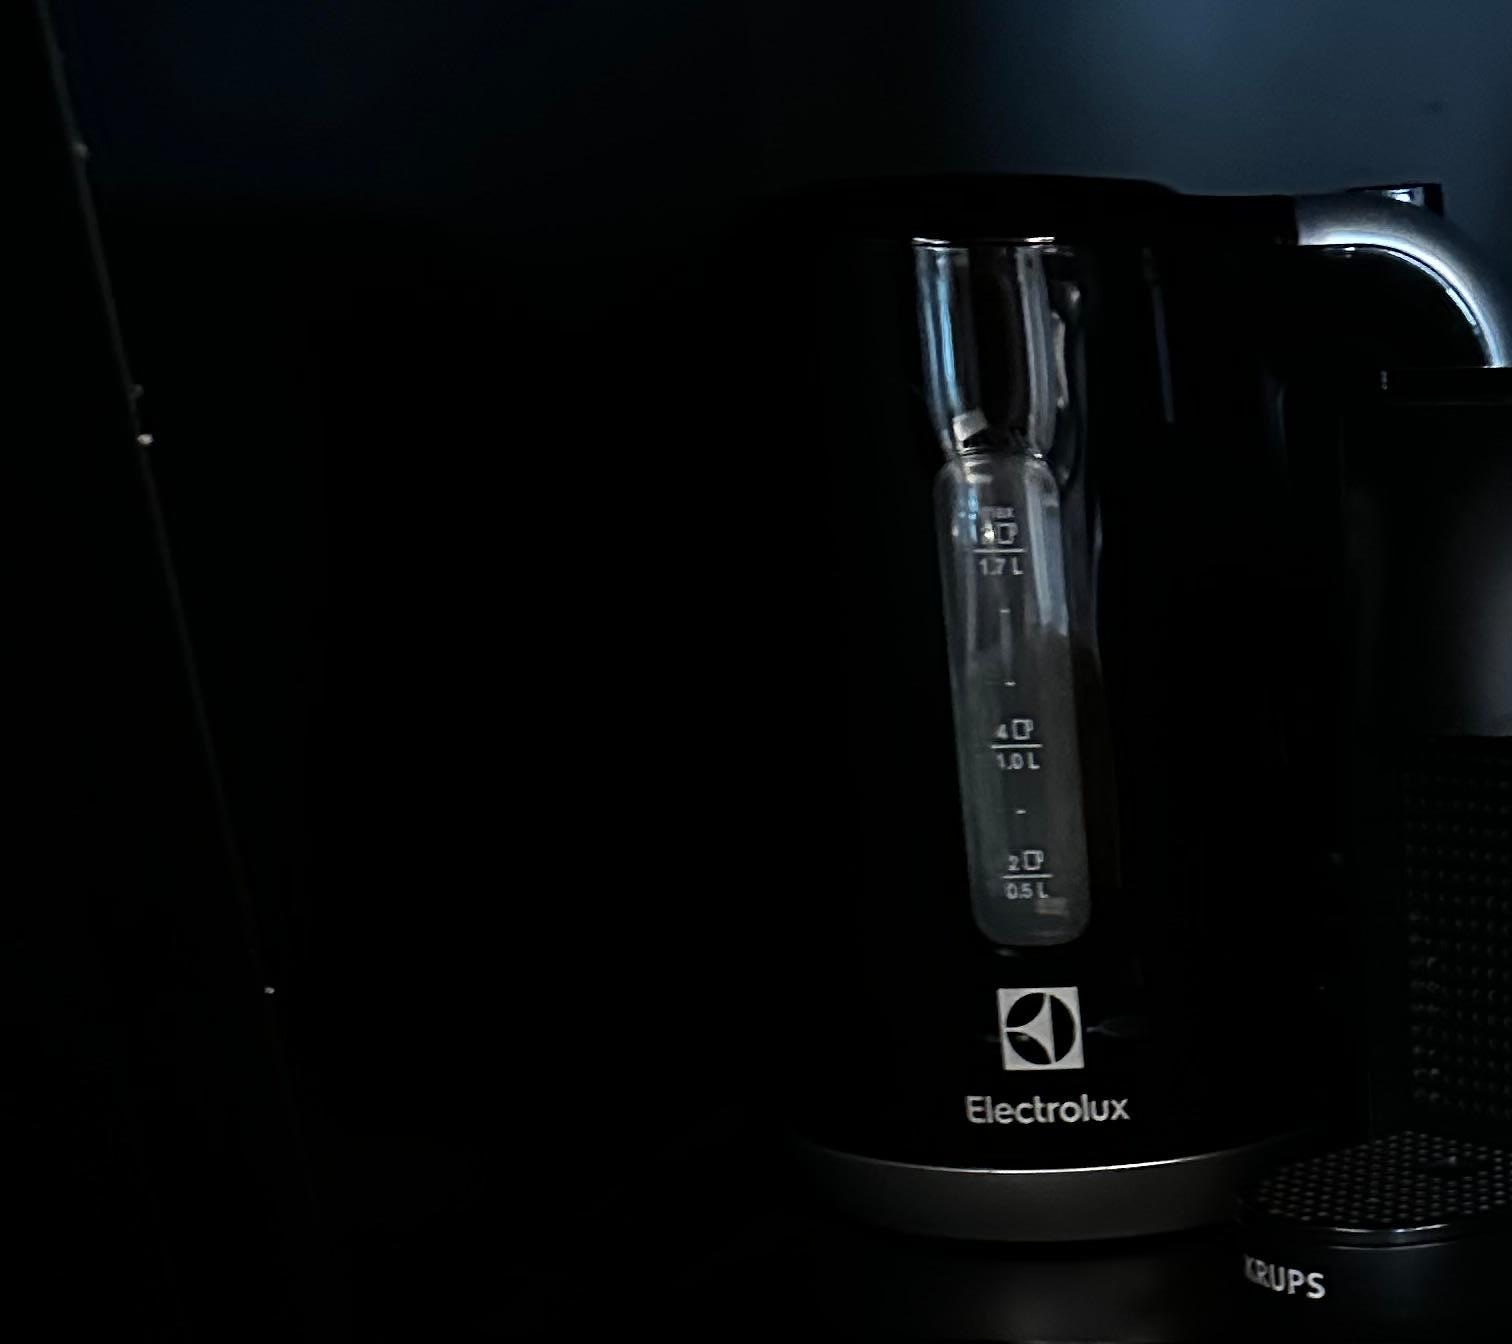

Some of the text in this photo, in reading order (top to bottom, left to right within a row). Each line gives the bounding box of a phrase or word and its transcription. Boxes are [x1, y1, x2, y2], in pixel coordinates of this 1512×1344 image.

[996, 724, 1009, 739] 4
[996, 752, 1040, 770] 1.0 L
[1007, 855, 1020, 871] 2
[1005, 882, 1049, 900] 0.5 L
[965, 1093, 1131, 1124] Electrolux
[1243, 1252, 1326, 1299] KRUPS
